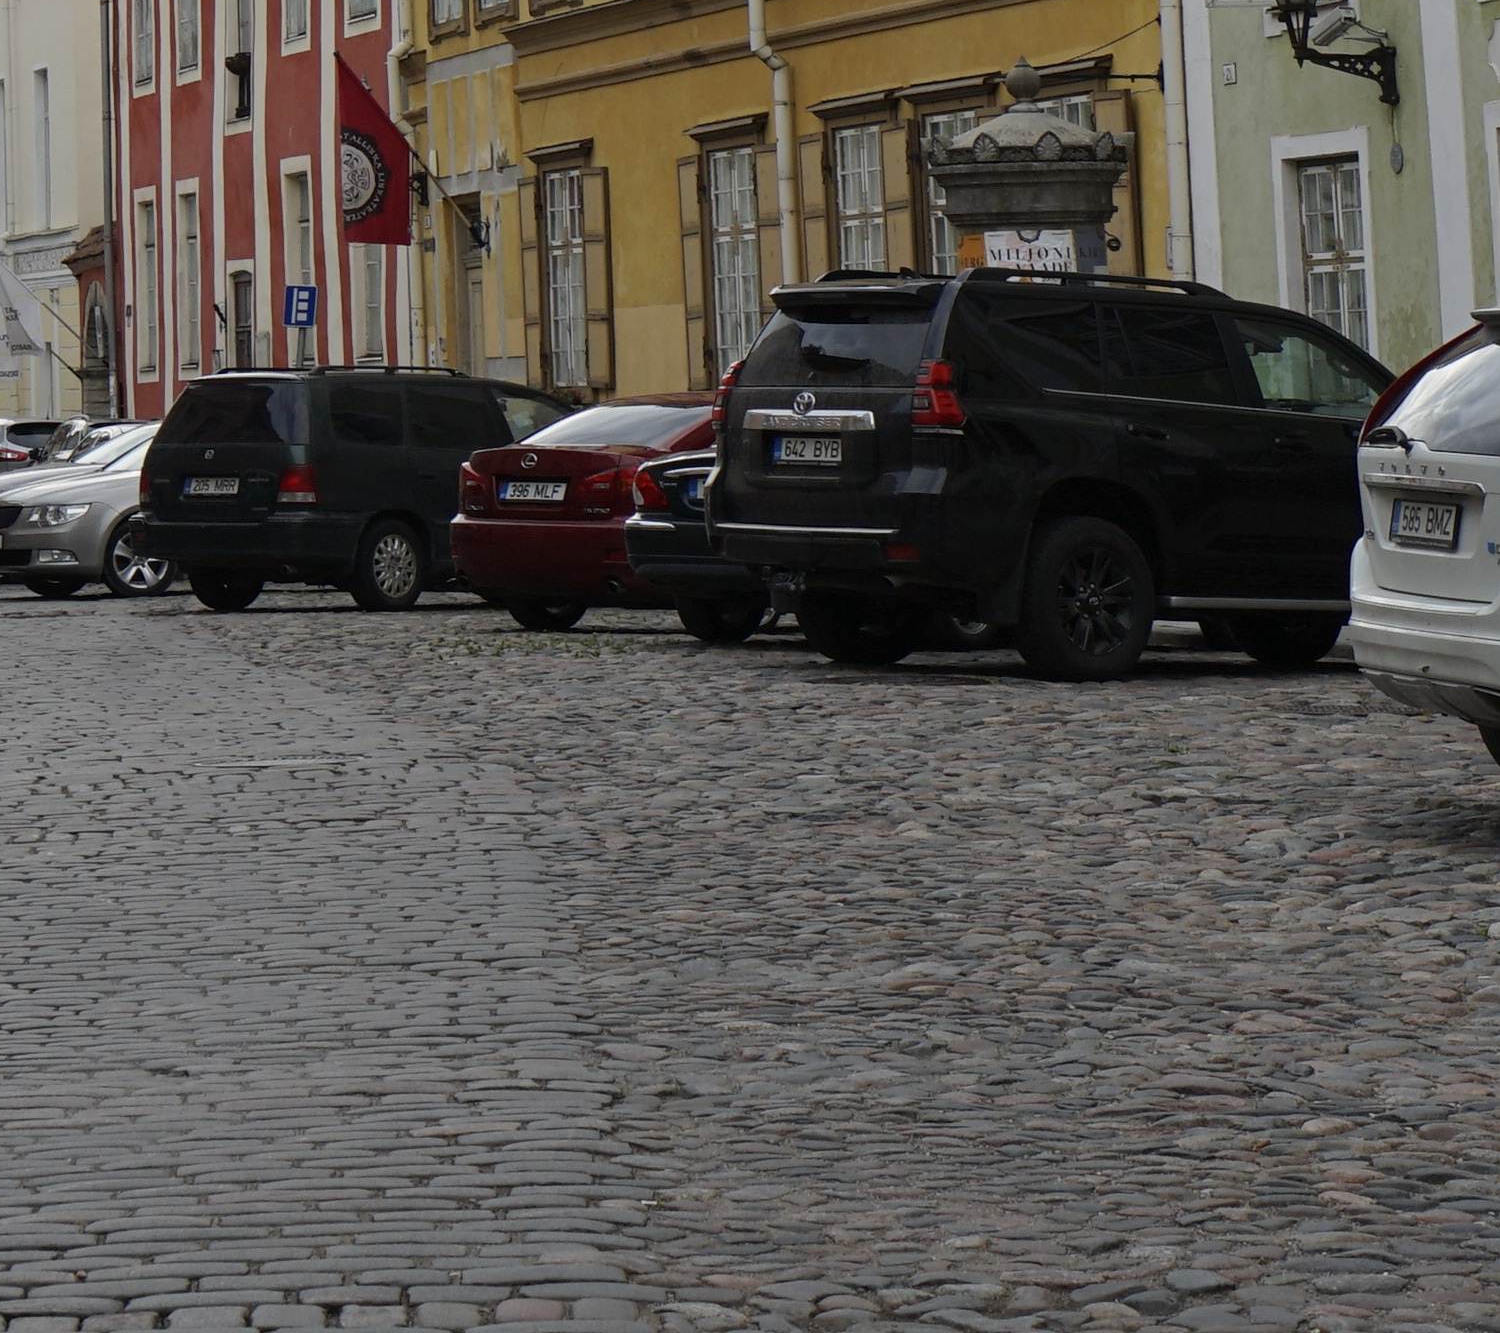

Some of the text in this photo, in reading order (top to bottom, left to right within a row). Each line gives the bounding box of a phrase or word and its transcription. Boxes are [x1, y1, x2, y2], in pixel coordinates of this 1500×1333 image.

[990, 246, 1071, 263] MILJONI
[785, 440, 840, 457] 642 BYB
[193, 479, 210, 492] 205
[510, 483, 562, 499] 396 MLF
[1402, 505, 1453, 535] 585 BMZ
